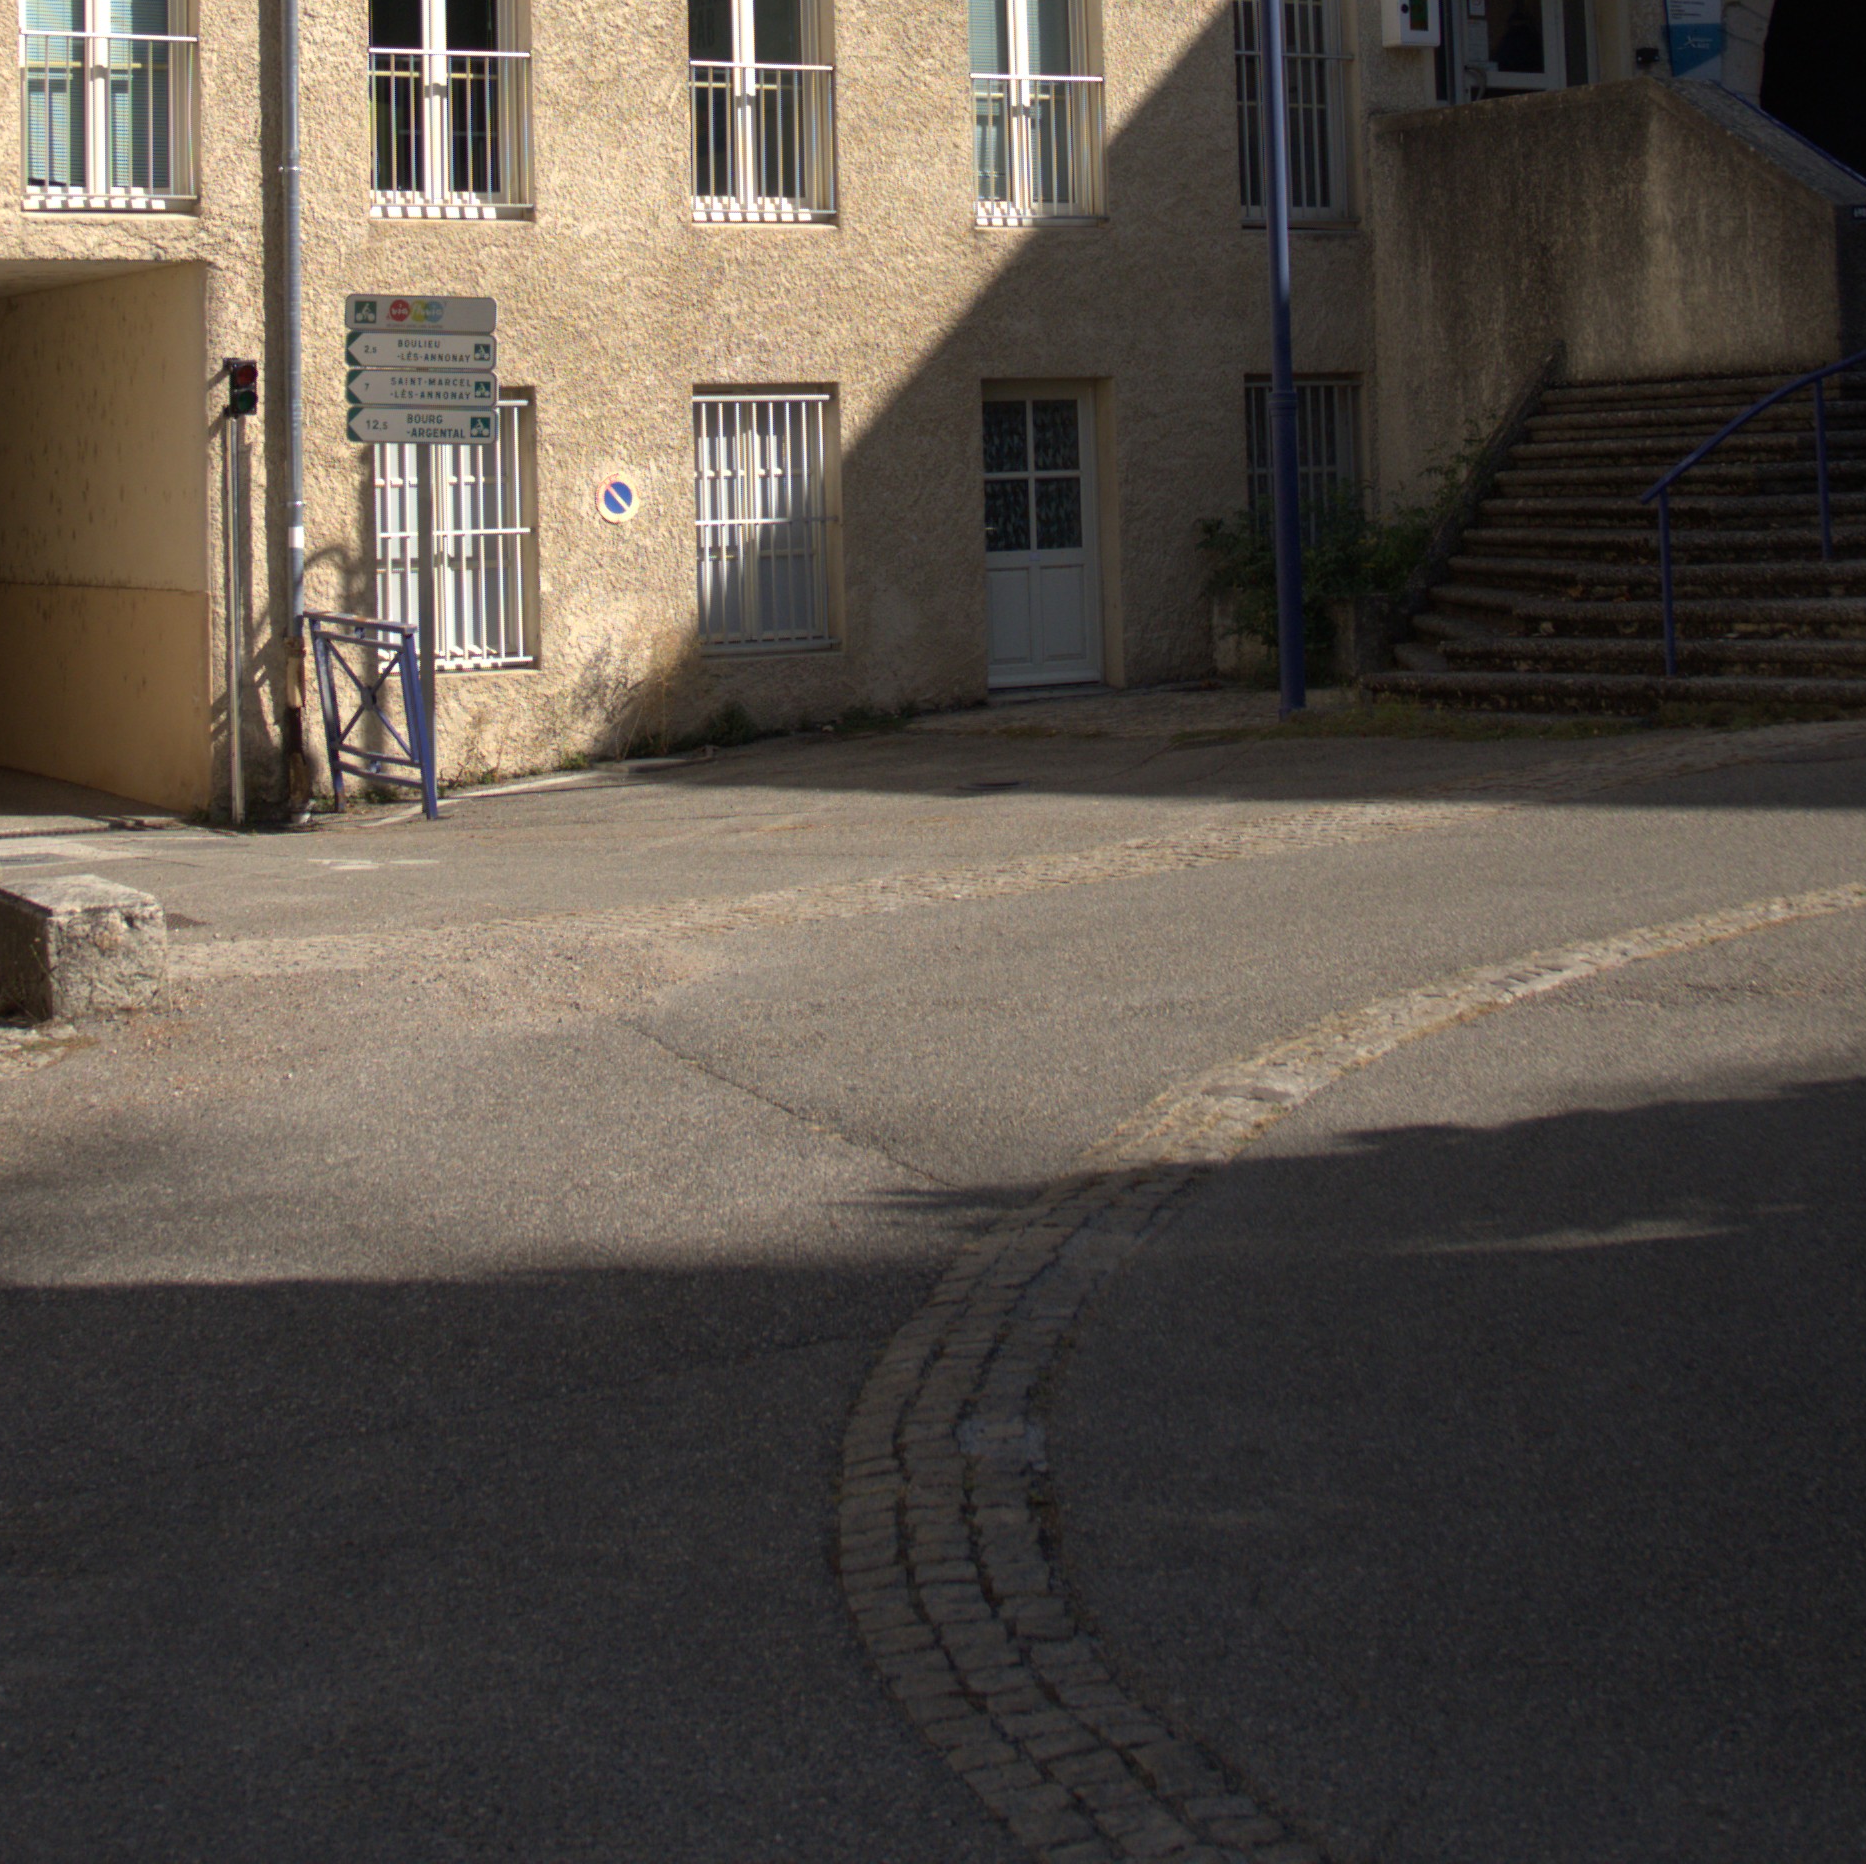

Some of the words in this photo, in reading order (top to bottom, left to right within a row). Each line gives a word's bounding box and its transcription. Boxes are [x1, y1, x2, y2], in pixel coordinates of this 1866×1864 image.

[397, 339, 442, 349] BOULIEU
[364, 383, 371, 392] 7
[390, 376, 472, 388] SAINT-MARCEL
[366, 419, 389, 431] 12,5
[406, 413, 443, 425] BOURG
[406, 427, 466, 440] -ARGENTAL
